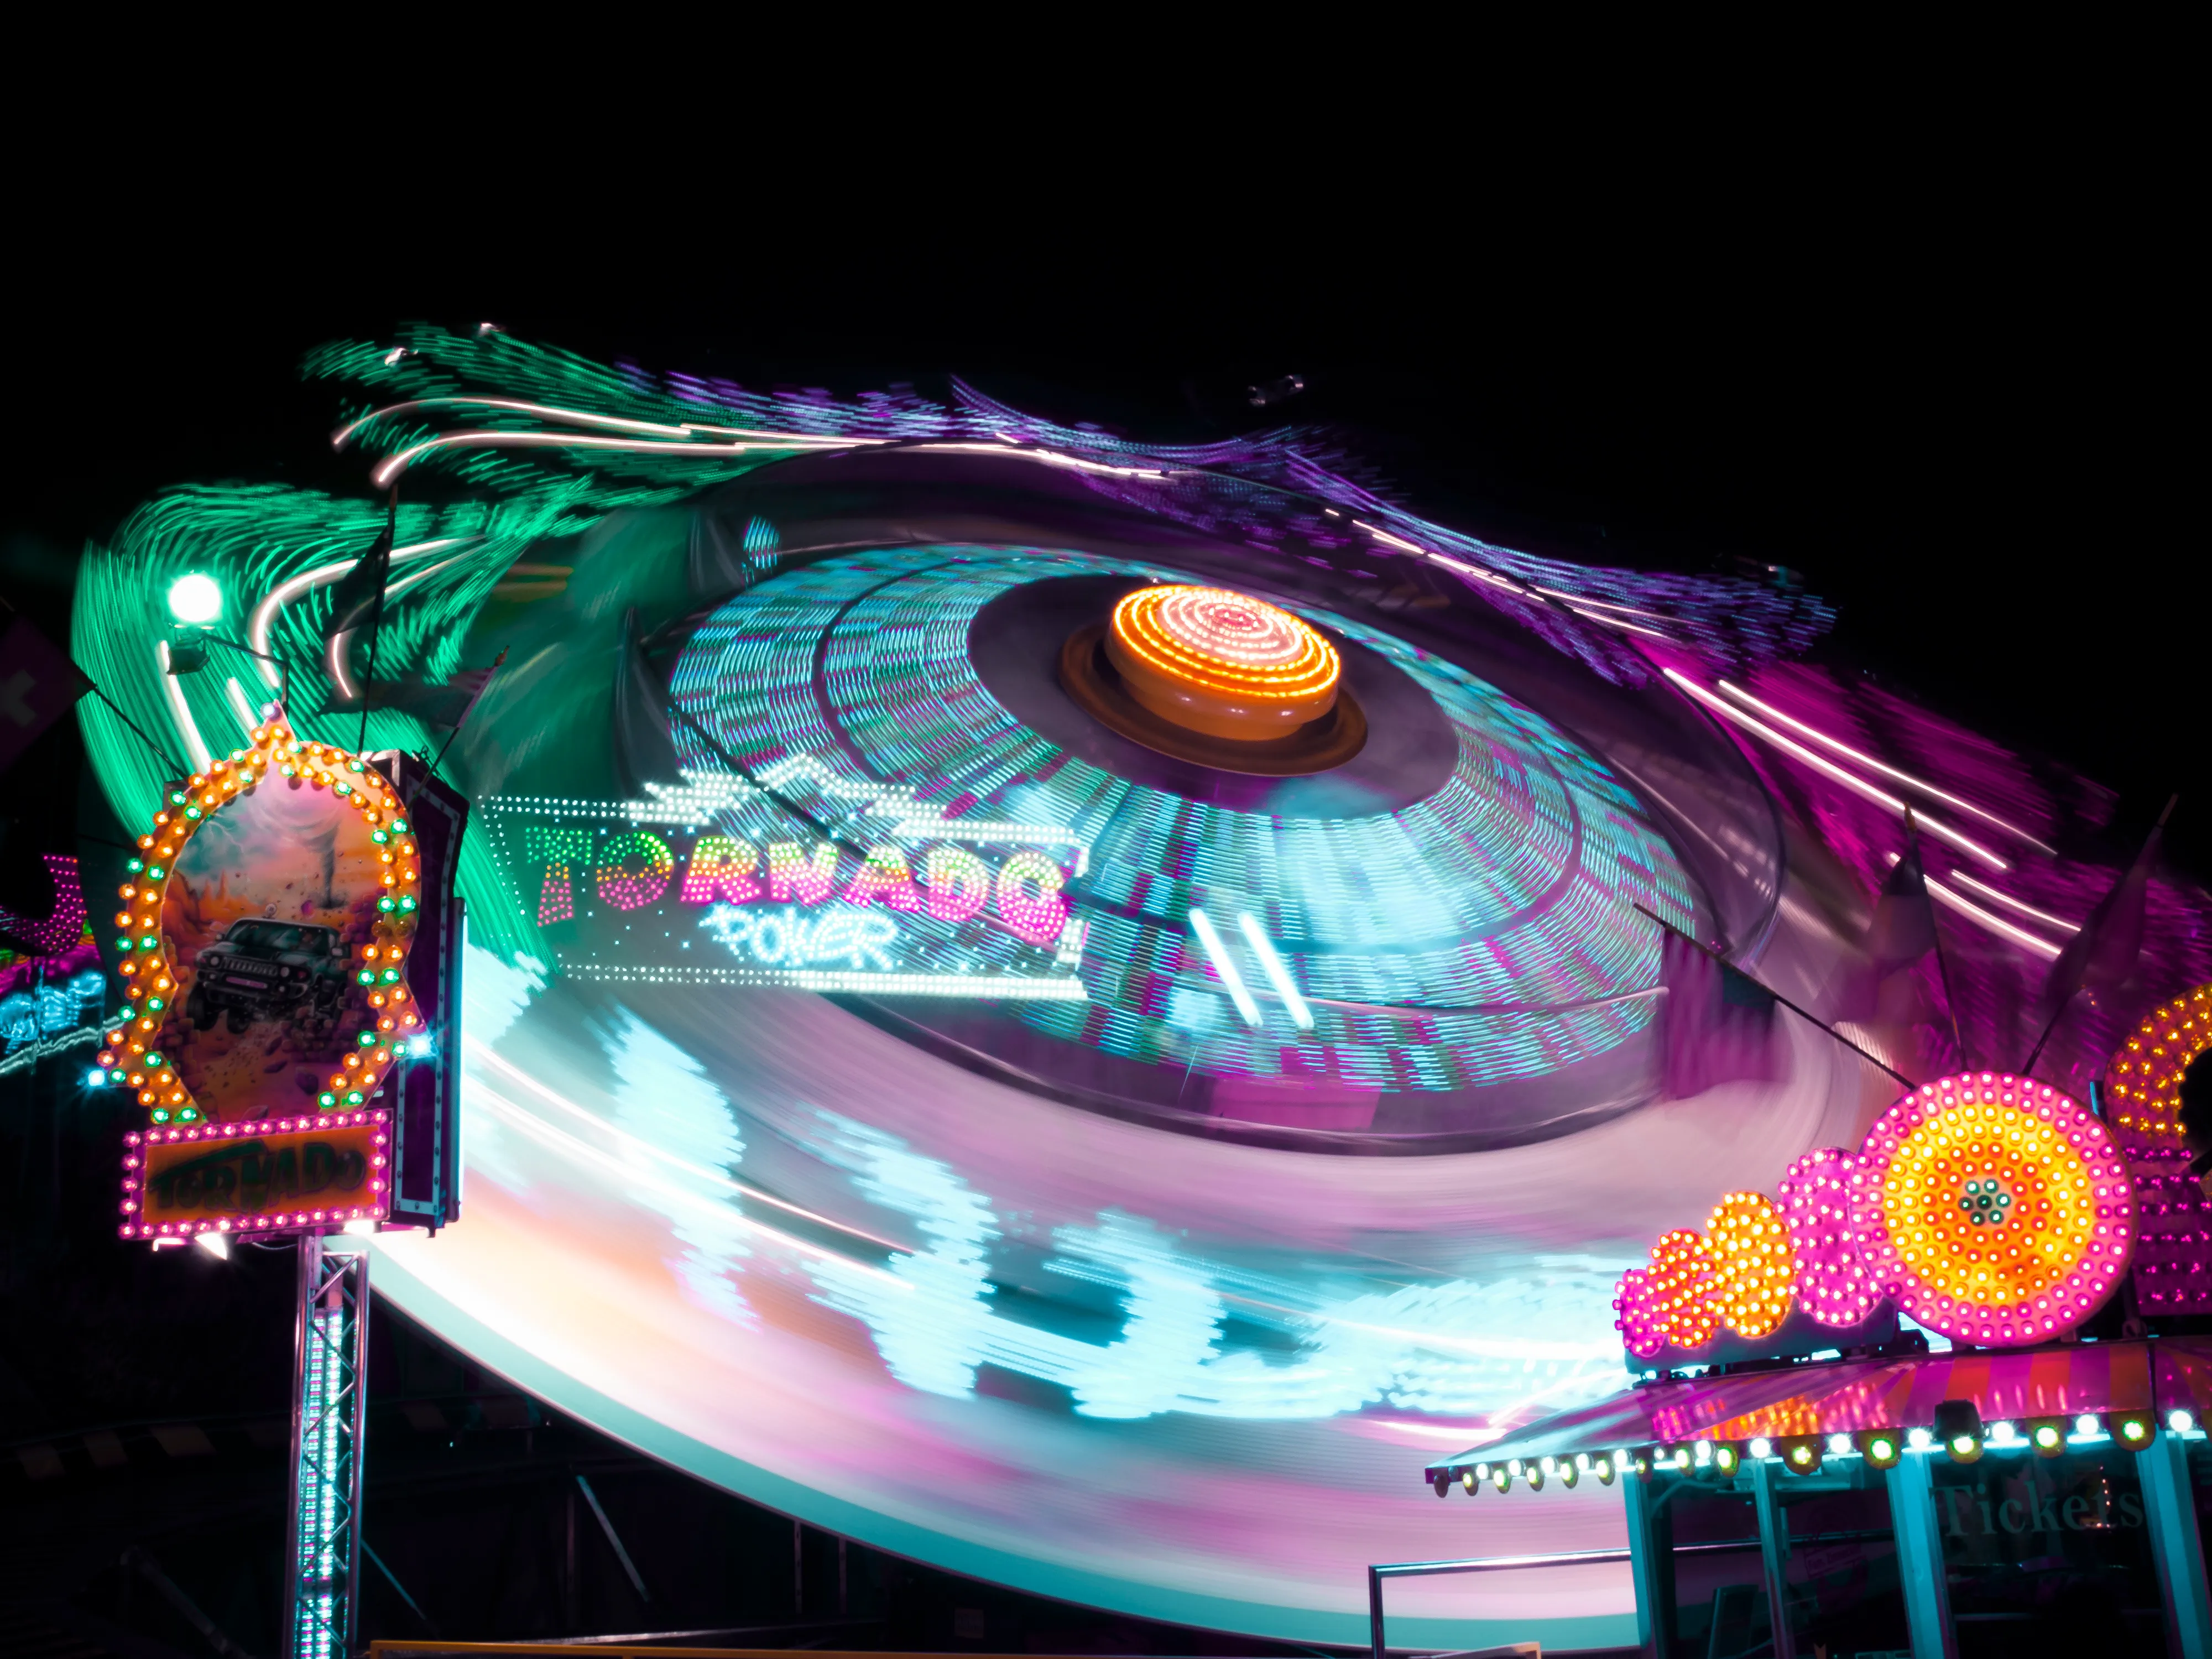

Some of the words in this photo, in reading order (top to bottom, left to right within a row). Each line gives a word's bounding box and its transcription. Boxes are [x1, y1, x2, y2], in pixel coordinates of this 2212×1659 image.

[525, 825, 1067, 945] TORNADO
[149, 1139, 367, 1213] TORNADO
[1929, 1480, 2145, 1537] Tickets
